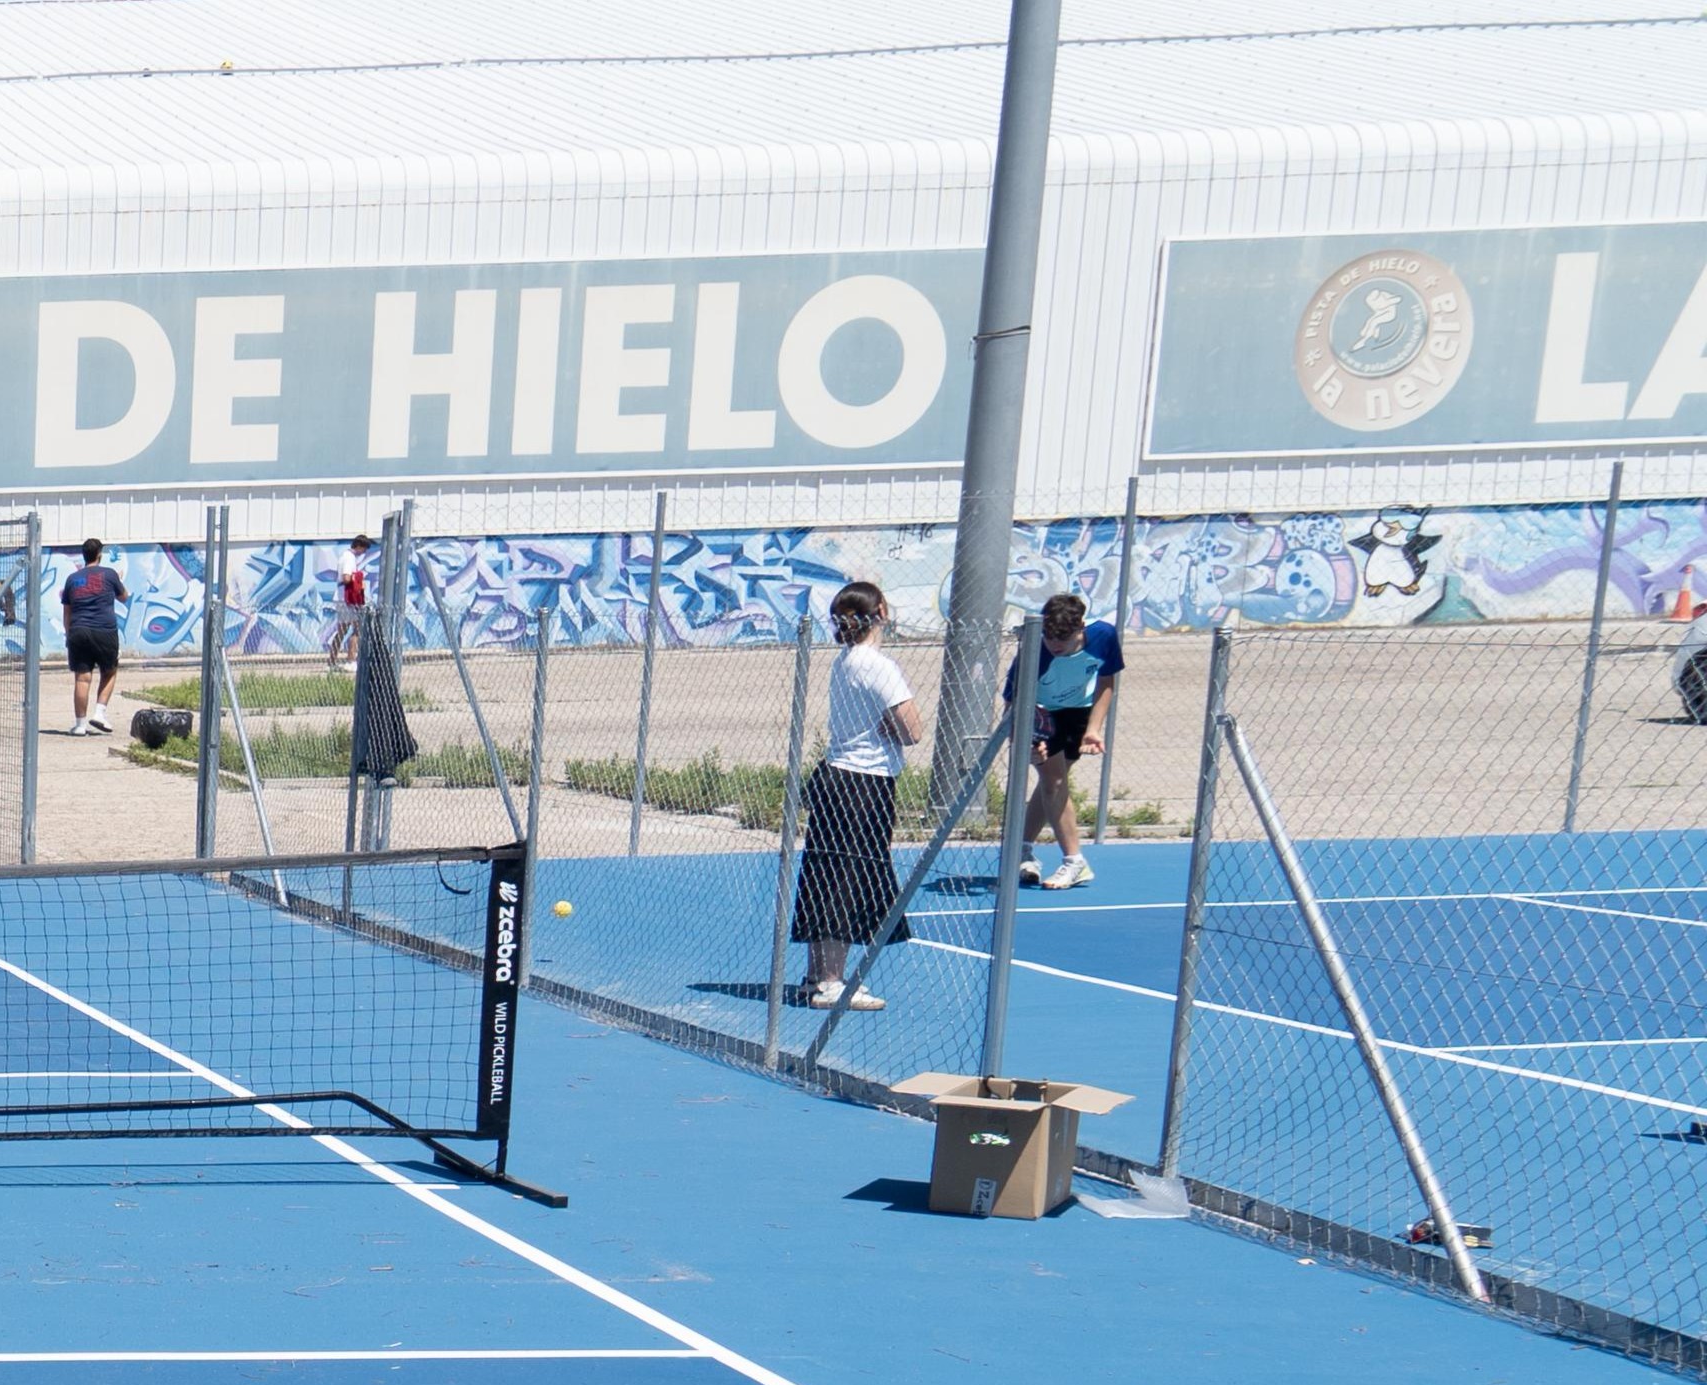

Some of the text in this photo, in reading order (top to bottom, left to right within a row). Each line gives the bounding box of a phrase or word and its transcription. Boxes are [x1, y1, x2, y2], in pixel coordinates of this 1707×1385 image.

[1305, 256, 1421, 340] PISTA DE HIELO
[34, 294, 285, 468] DE
[367, 274, 948, 460] HIELO
[1312, 291, 1461, 421] la nevera
[495, 906, 517, 983] zcebra
[489, 1001, 508, 1105] WILD PICKLEBALL
